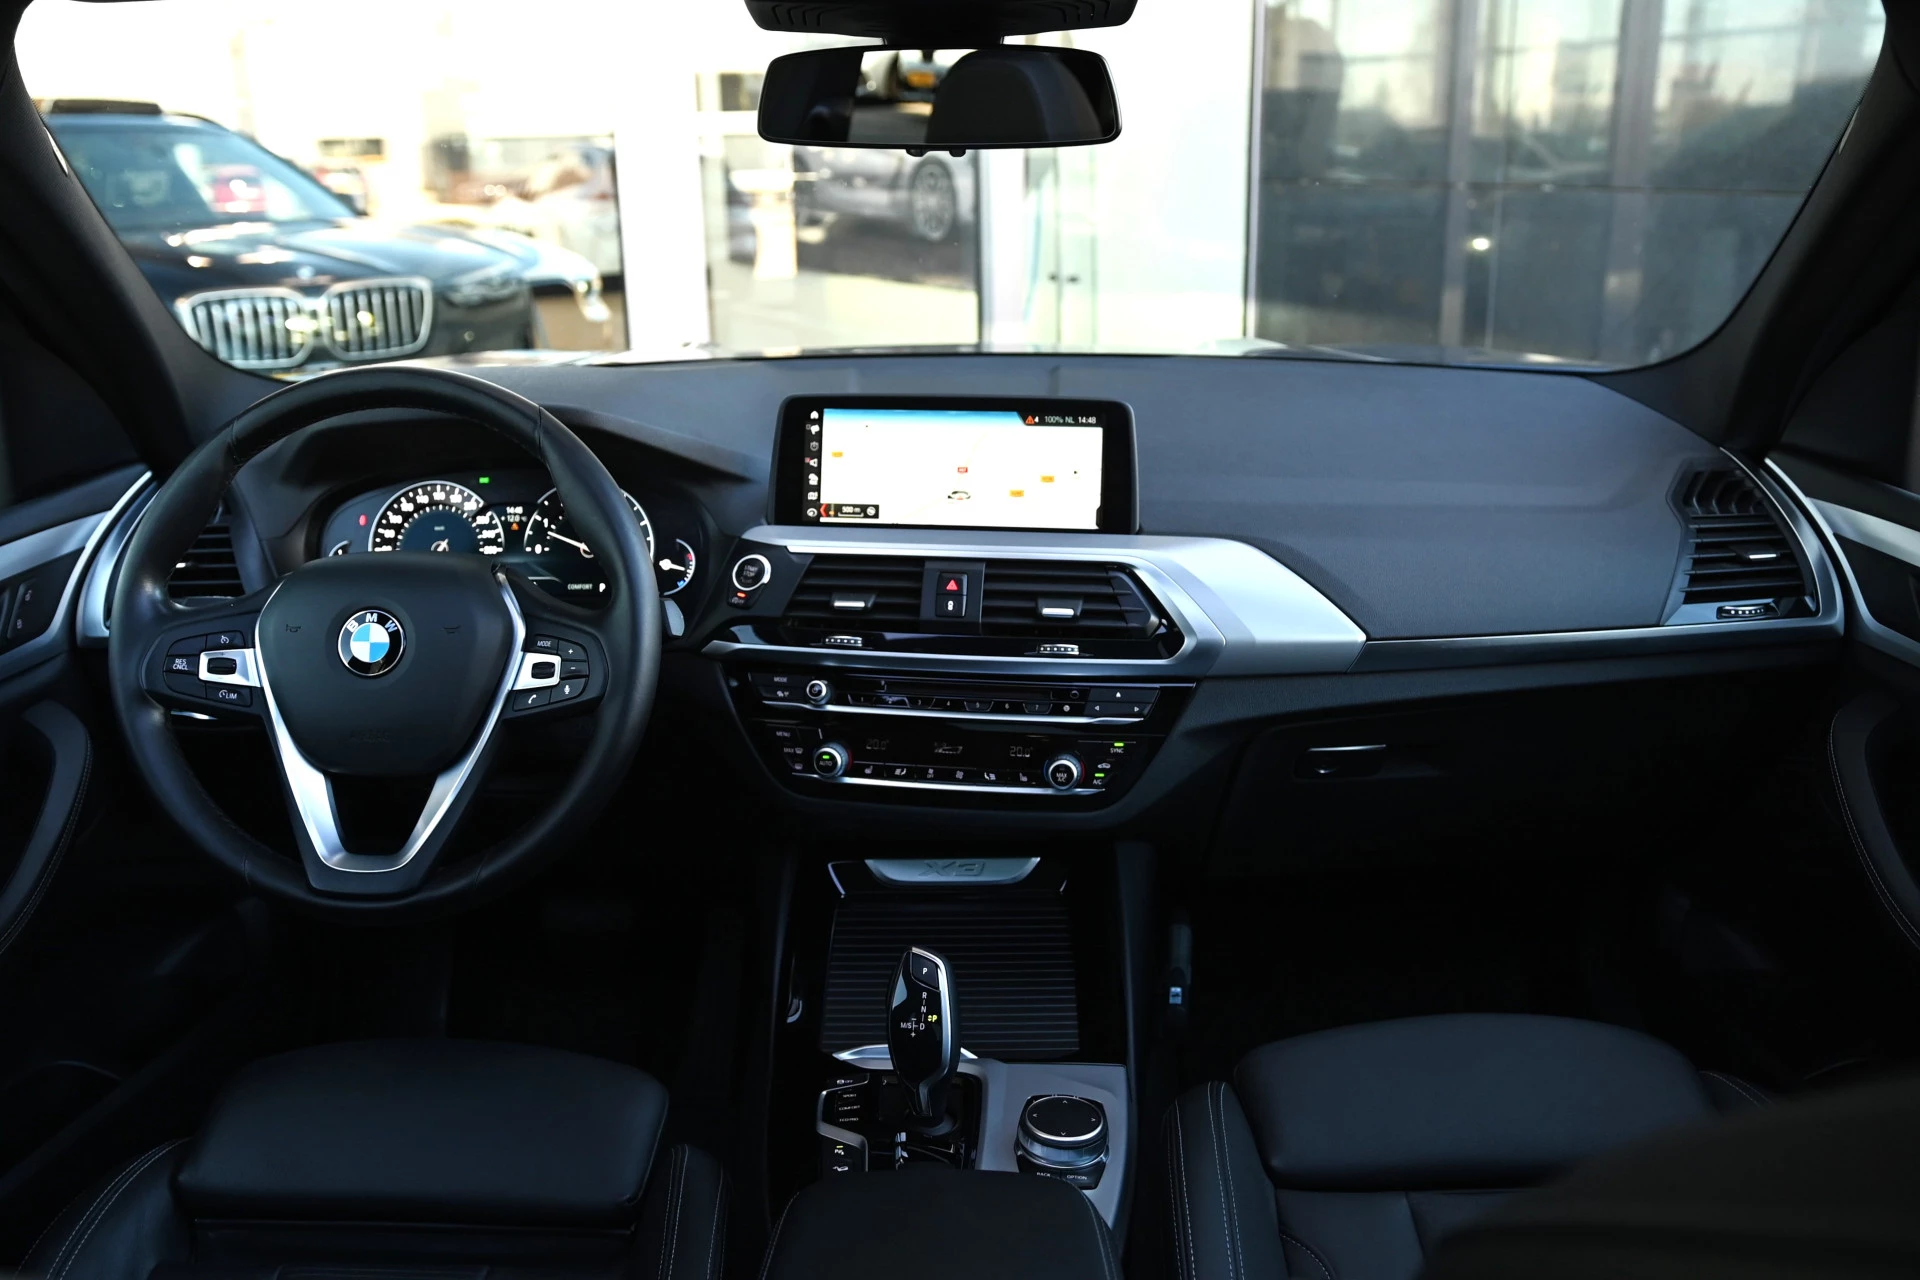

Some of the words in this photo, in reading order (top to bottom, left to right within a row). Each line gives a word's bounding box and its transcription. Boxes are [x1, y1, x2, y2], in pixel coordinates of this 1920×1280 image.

[1044, 416, 1064, 424] 100%
[1065, 416, 1075, 424] NL
[1078, 416, 1097, 424] 14:48
[346, 612, 398, 633] BMW
[225, 692, 238, 700] LIM
[922, 967, 928, 975] P
[922, 991, 927, 999] R
